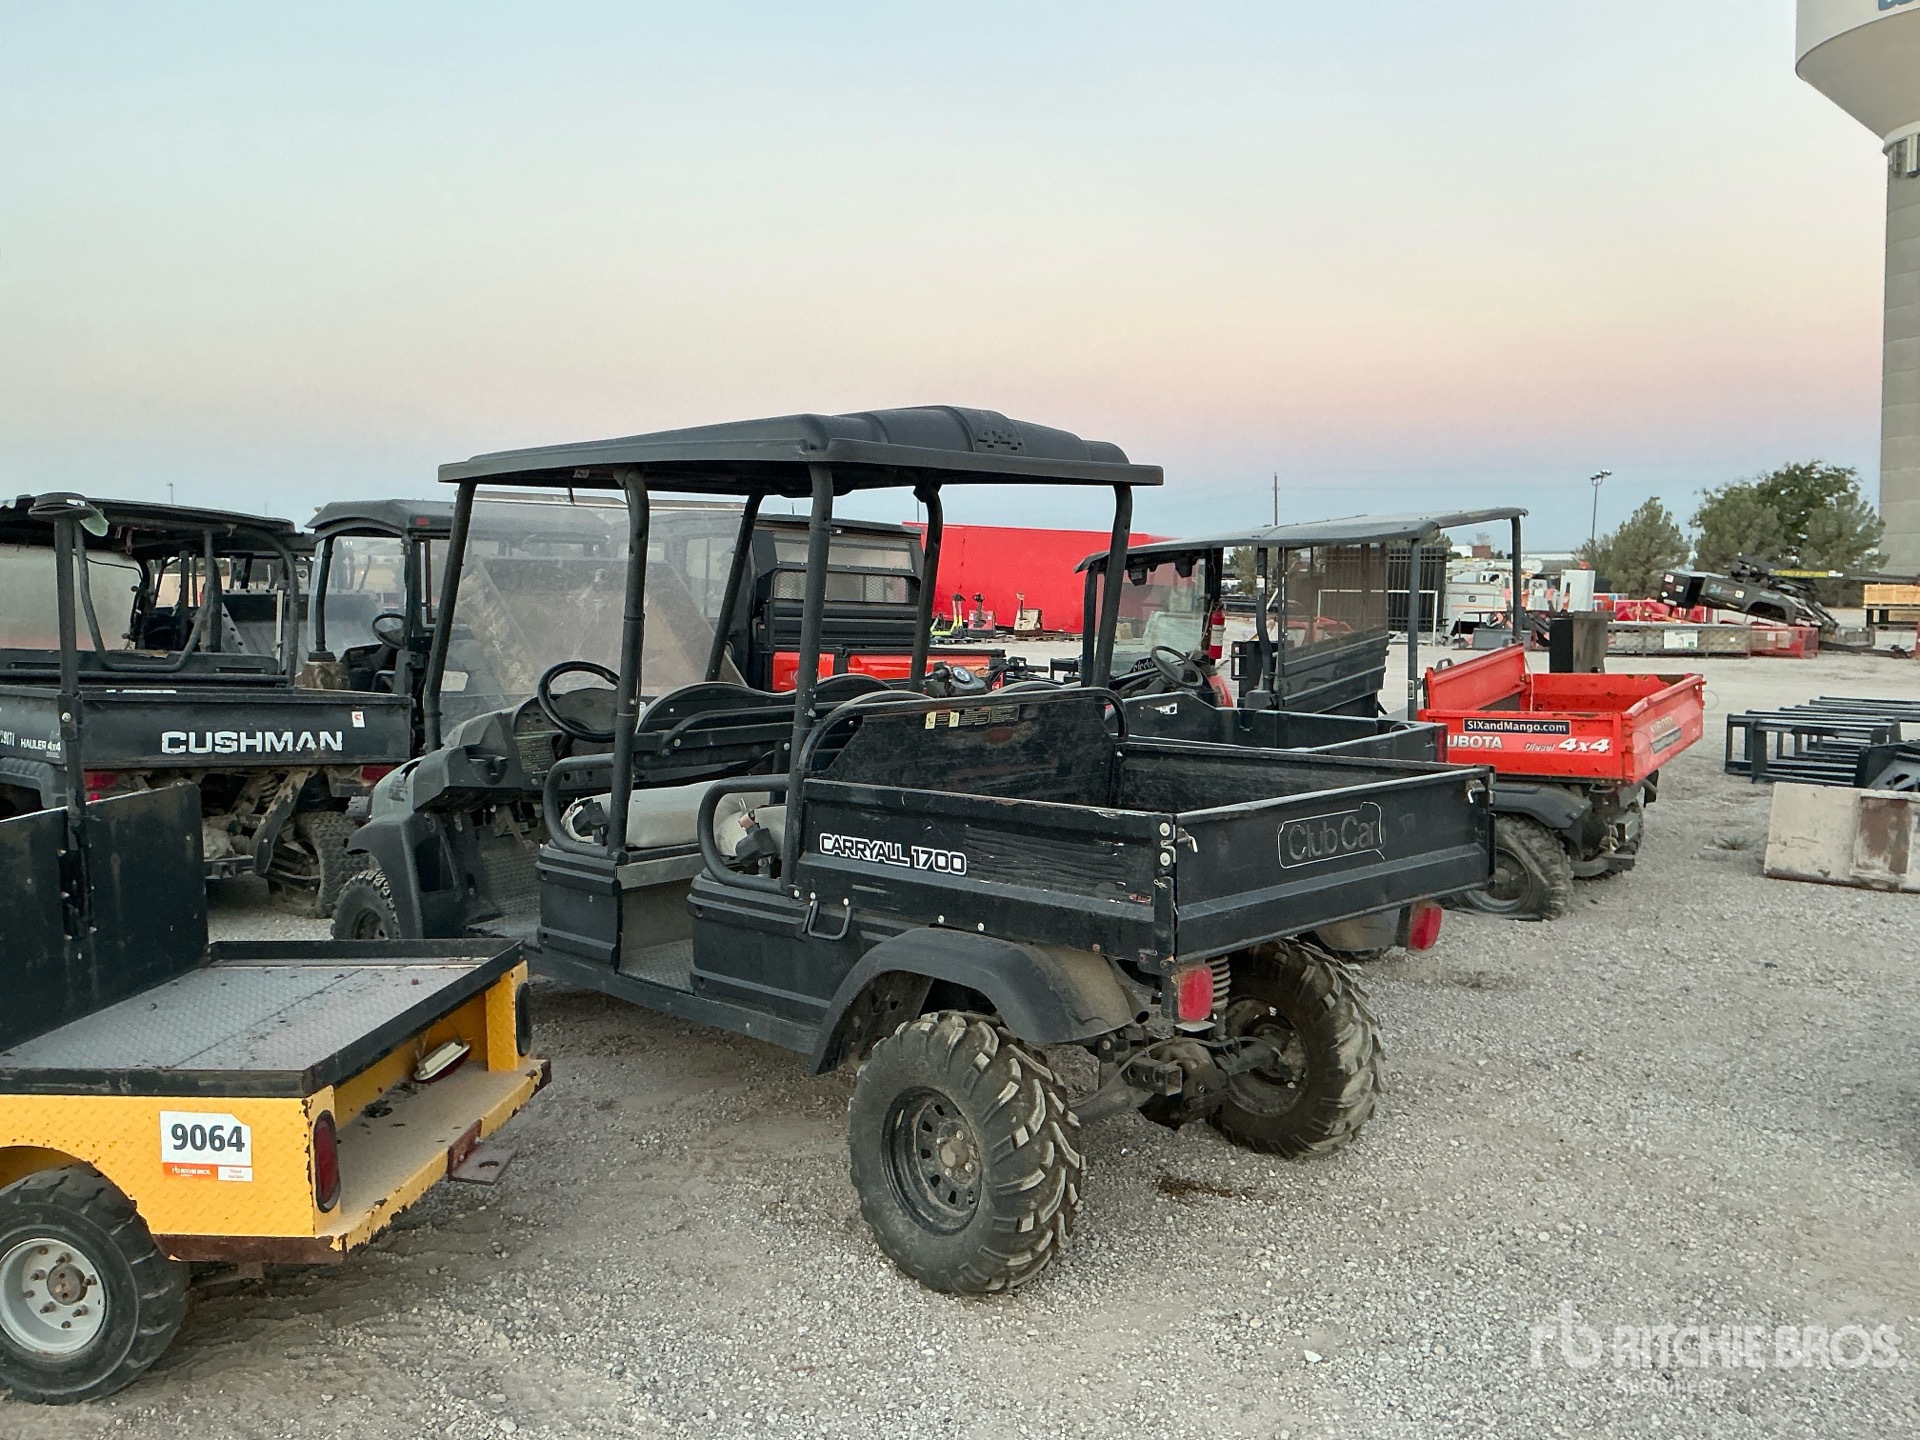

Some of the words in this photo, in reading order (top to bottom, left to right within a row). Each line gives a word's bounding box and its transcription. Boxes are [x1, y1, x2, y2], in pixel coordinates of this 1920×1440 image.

[1467, 720, 1566, 734] SIXandMango.com
[20, 738, 47, 750] HAULER
[161, 730, 343, 754] CUSHMAN
[1447, 734, 1503, 749] UBOTA
[1558, 737, 1610, 753] 4x4
[1288, 821, 1338, 860] Club
[1341, 815, 1377, 851] Car
[819, 832, 911, 867] CARRYALL
[911, 846, 968, 876] 1700
[171, 1123, 245, 1152] 9064
